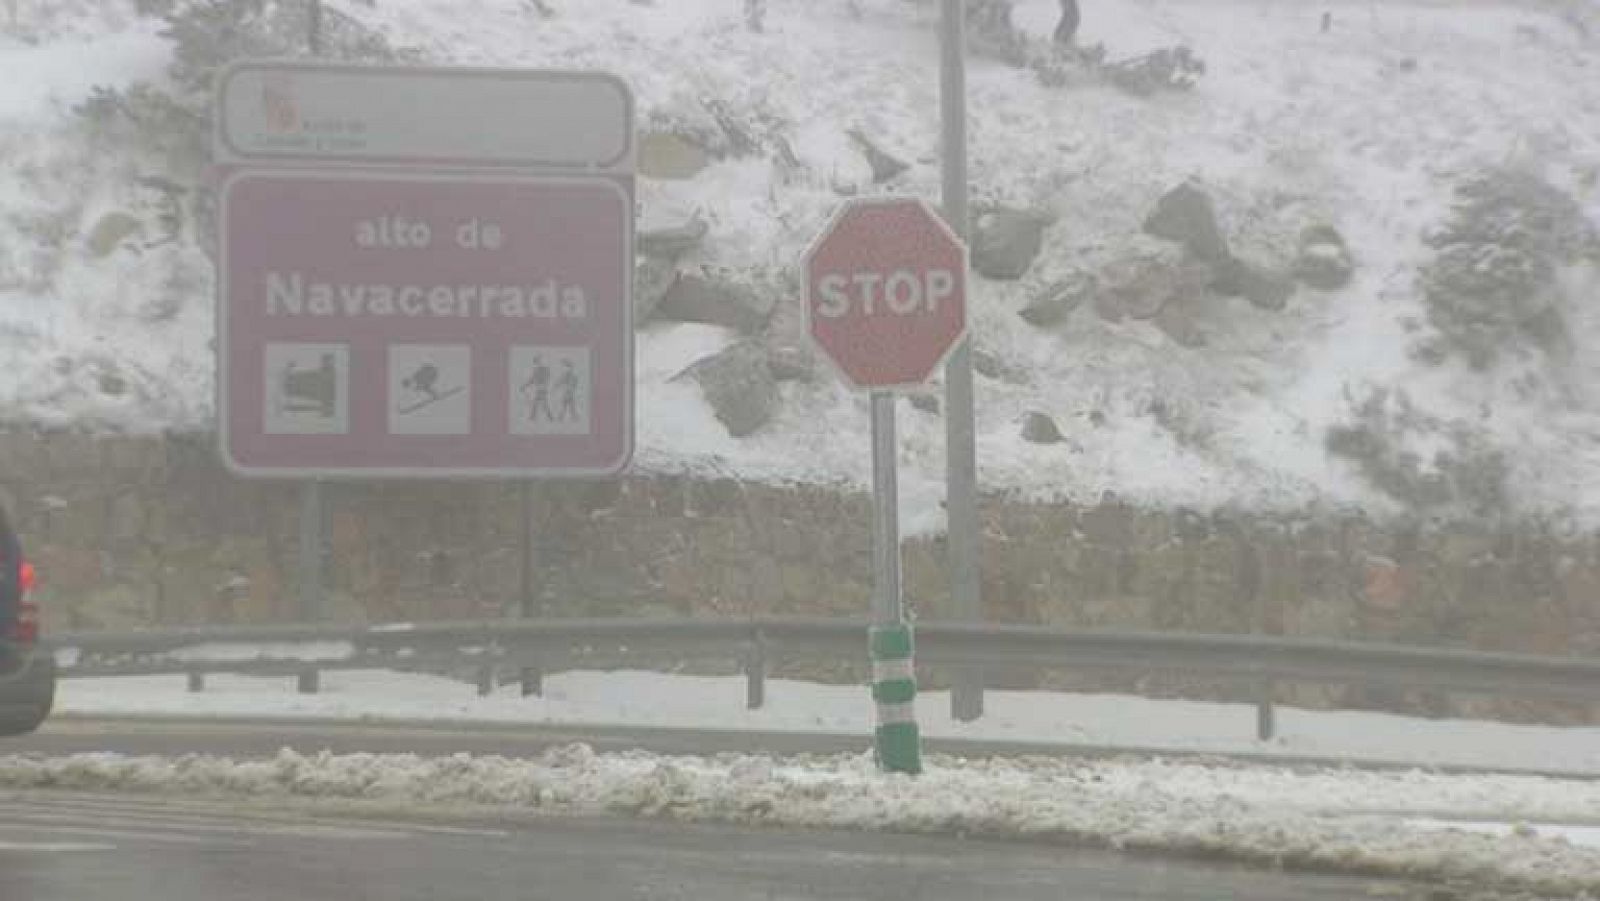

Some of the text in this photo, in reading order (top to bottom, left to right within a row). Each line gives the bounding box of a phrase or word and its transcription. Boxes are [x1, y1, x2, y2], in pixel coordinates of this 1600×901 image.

[355, 217, 502, 248] alto de
[266, 273, 587, 317] Navacerrada
[817, 270, 953, 317] STOP
